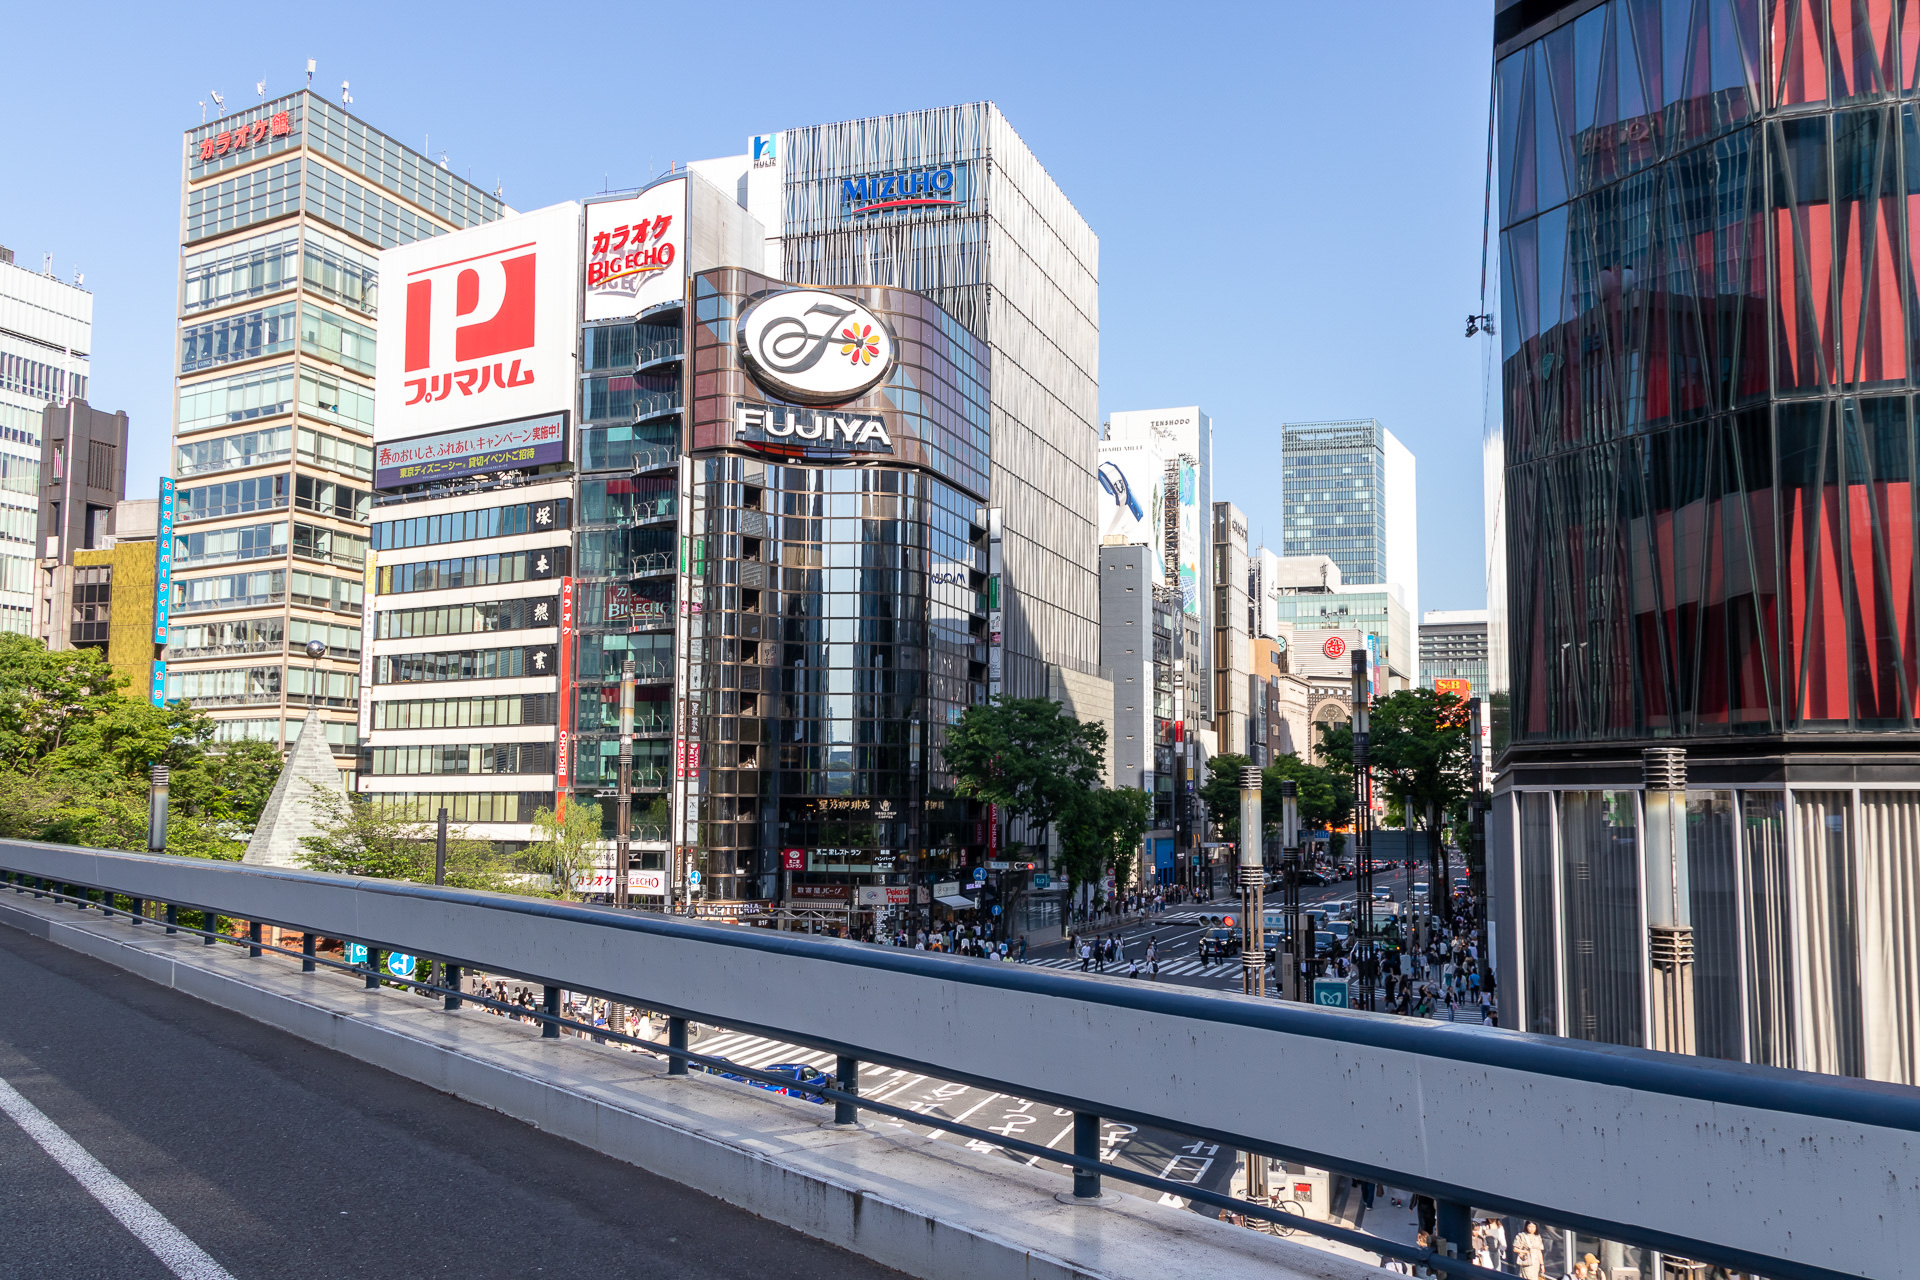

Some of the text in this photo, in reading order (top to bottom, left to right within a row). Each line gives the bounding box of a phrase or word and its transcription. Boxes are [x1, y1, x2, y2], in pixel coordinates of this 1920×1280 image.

[199, 111, 291, 160] カラオケ館
[753, 159, 776, 169] HULIC
[842, 170, 954, 202] MIZUHO
[592, 215, 673, 256] カラオケ
[588, 242, 676, 286] BIG ECHO
[404, 358, 535, 406] プリマハム
[737, 408, 892, 446] FUJIYA
[1150, 418, 1190, 427] TENSHODO
[562, 585, 572, 636] カラオケ
[608, 603, 634, 618] BIG
[576, 875, 614, 887] カラオケ
[885, 887, 903, 896] Peko
